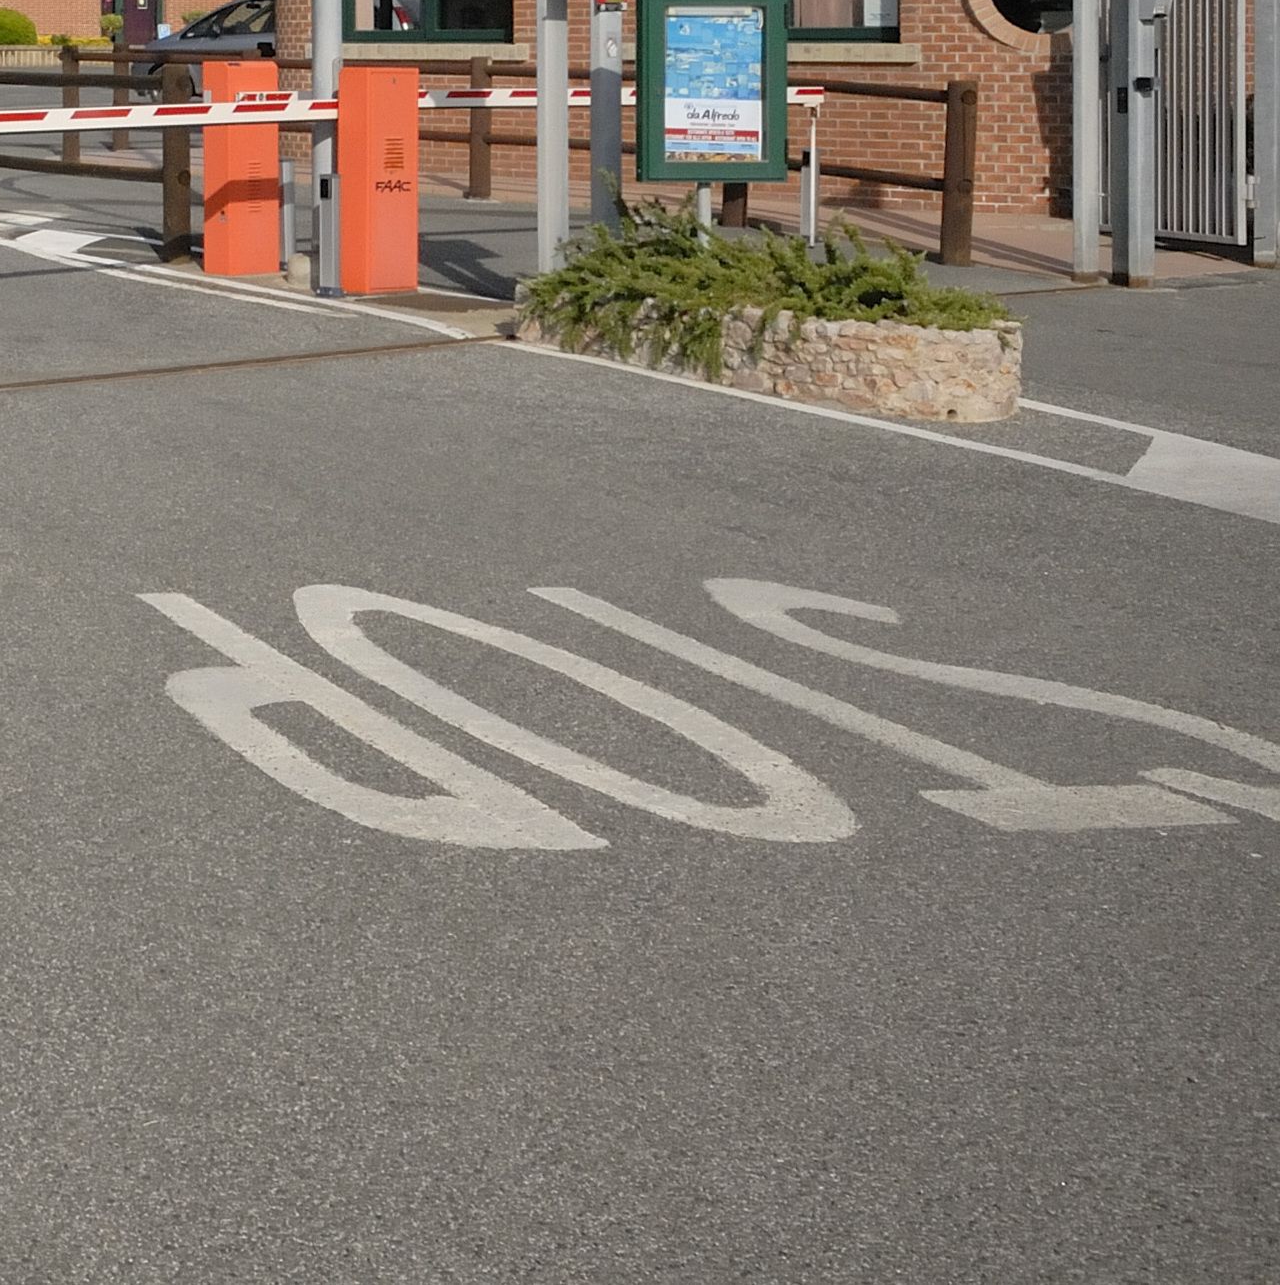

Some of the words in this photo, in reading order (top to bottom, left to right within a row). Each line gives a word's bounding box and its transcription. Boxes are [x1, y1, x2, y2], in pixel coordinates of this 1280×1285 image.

[701, 108, 740, 122] Alfredo
[375, 179, 412, 193] FAAC
[135, 577, 1280, 851] STOP
